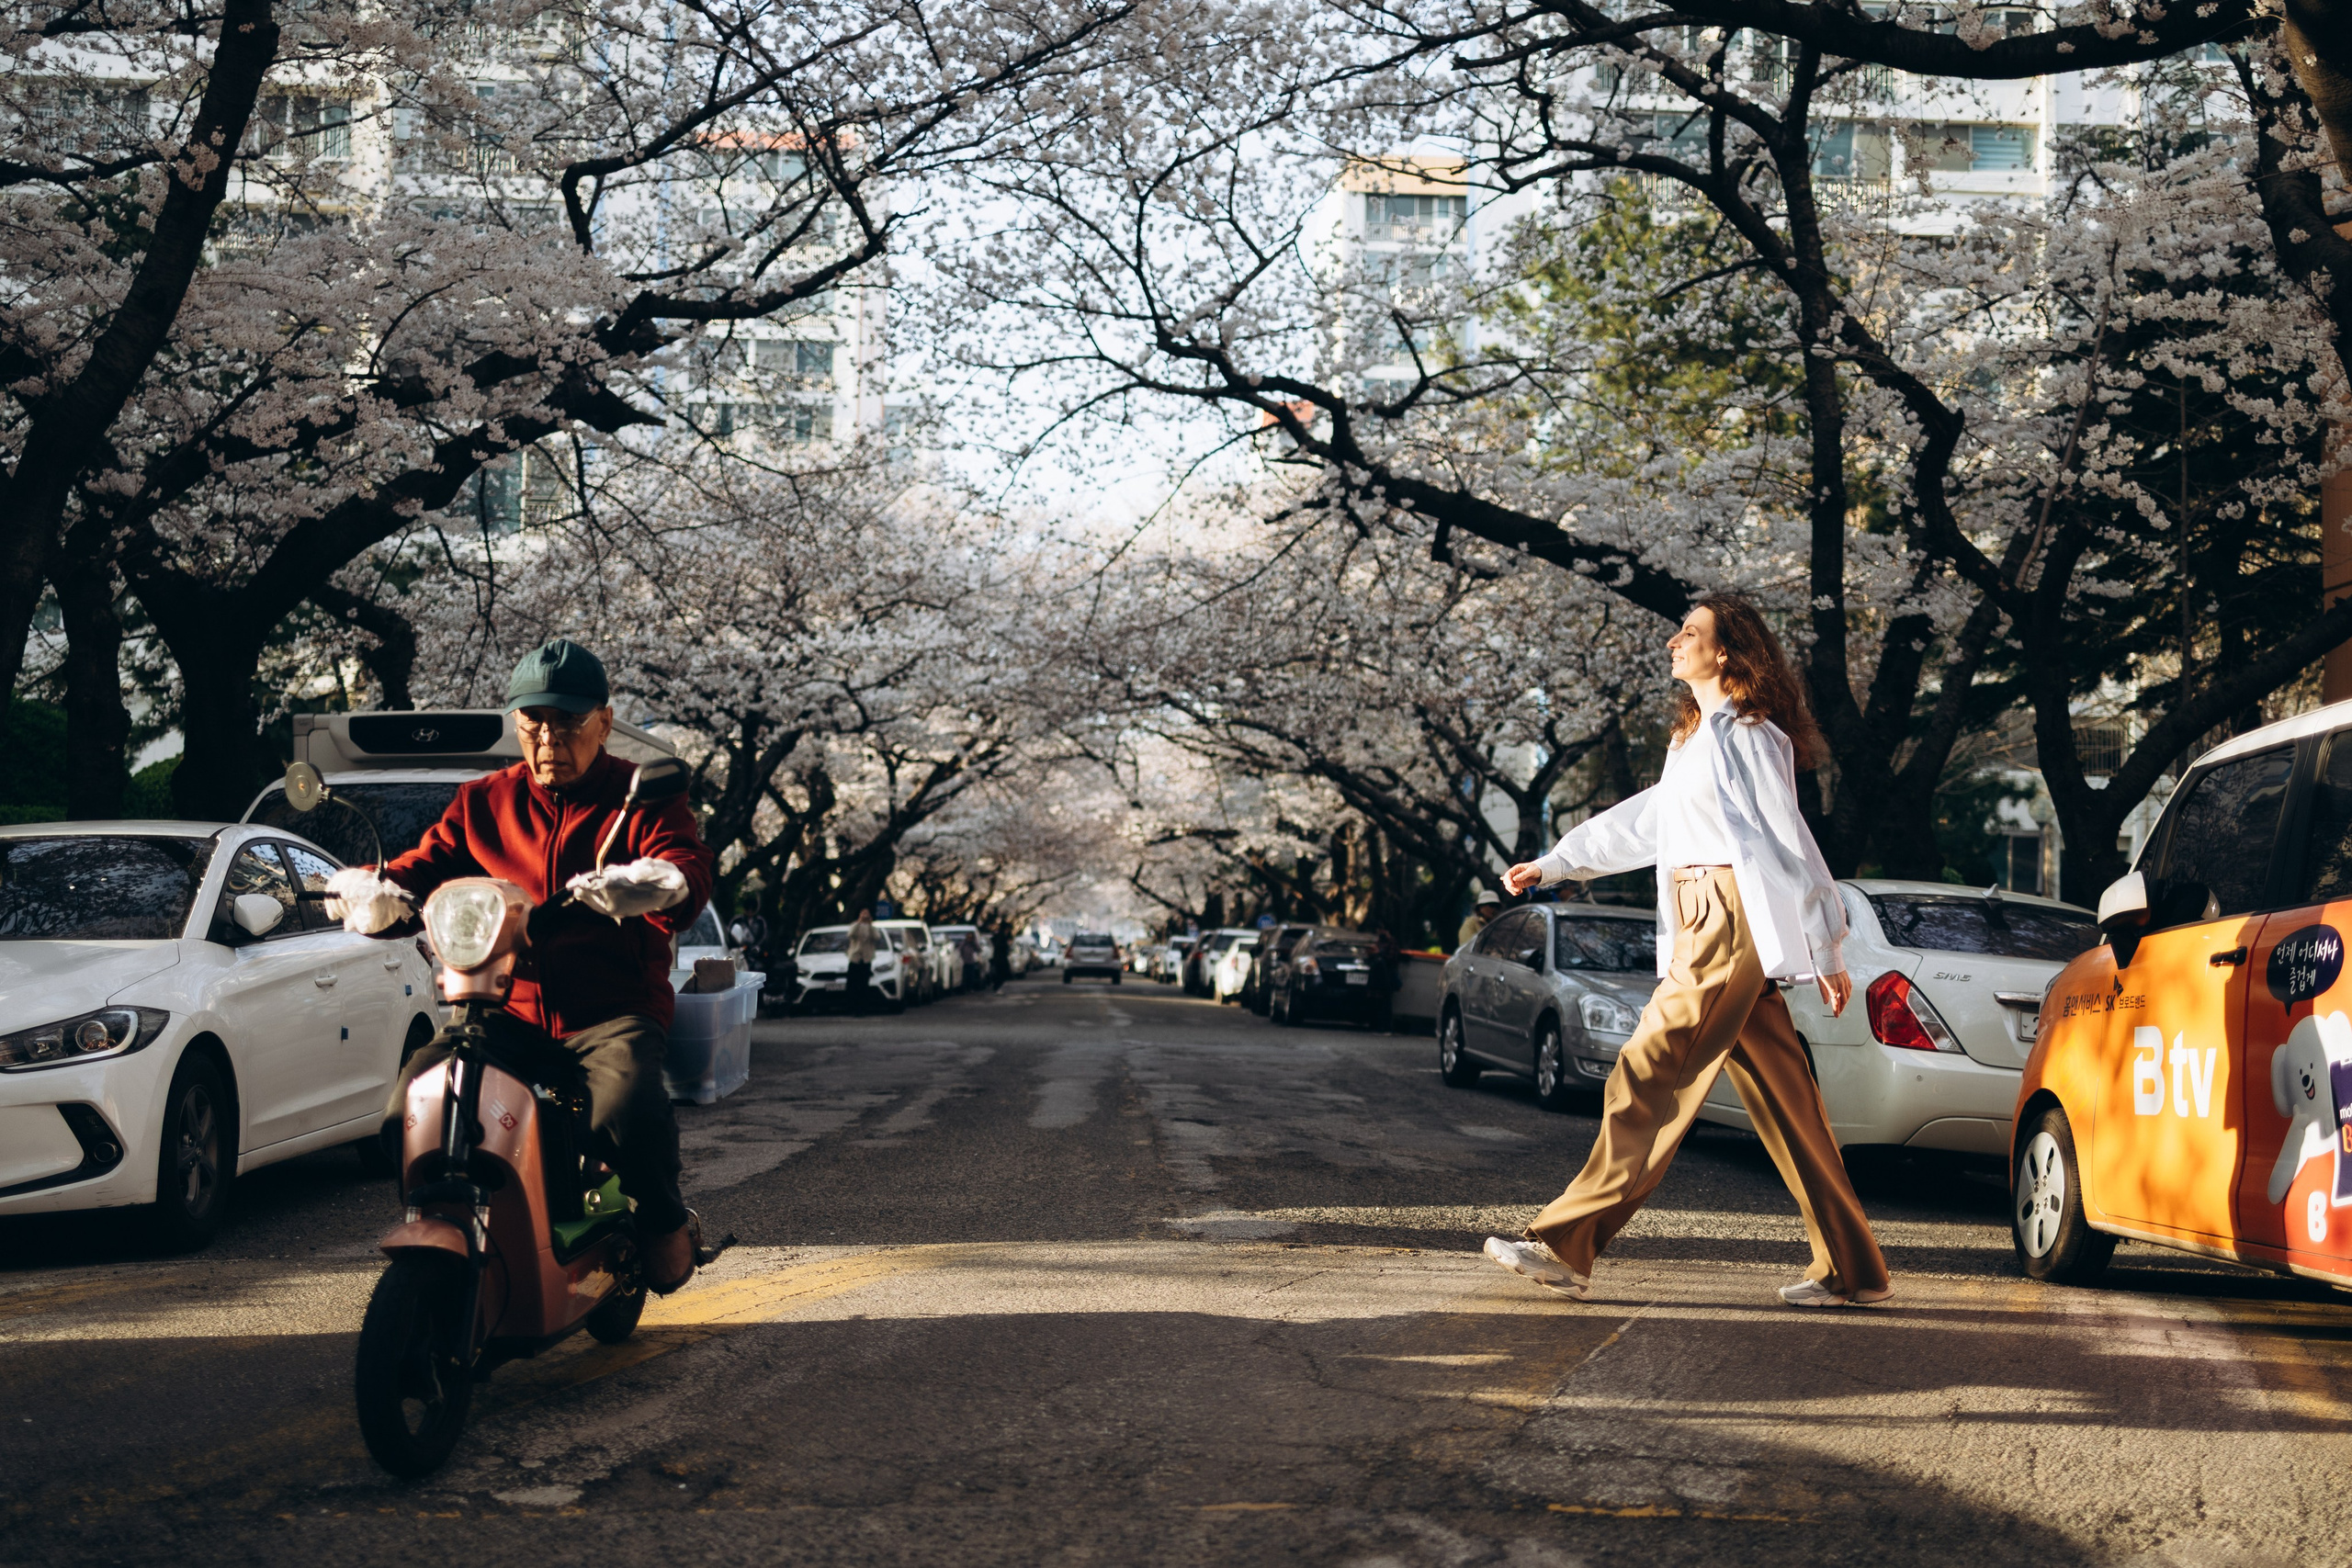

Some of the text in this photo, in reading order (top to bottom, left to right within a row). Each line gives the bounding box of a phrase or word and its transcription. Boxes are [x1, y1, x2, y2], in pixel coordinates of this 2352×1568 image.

[2277, 937, 2338, 964] 언제 어디서나
[1933, 972, 1972, 982] SM5
[2290, 965, 2316, 995] 즐겁게
[2063, 993, 2145, 1017] 홈앤서비스 SK 브로드밴드
[2307, 1190, 2327, 1243] B
